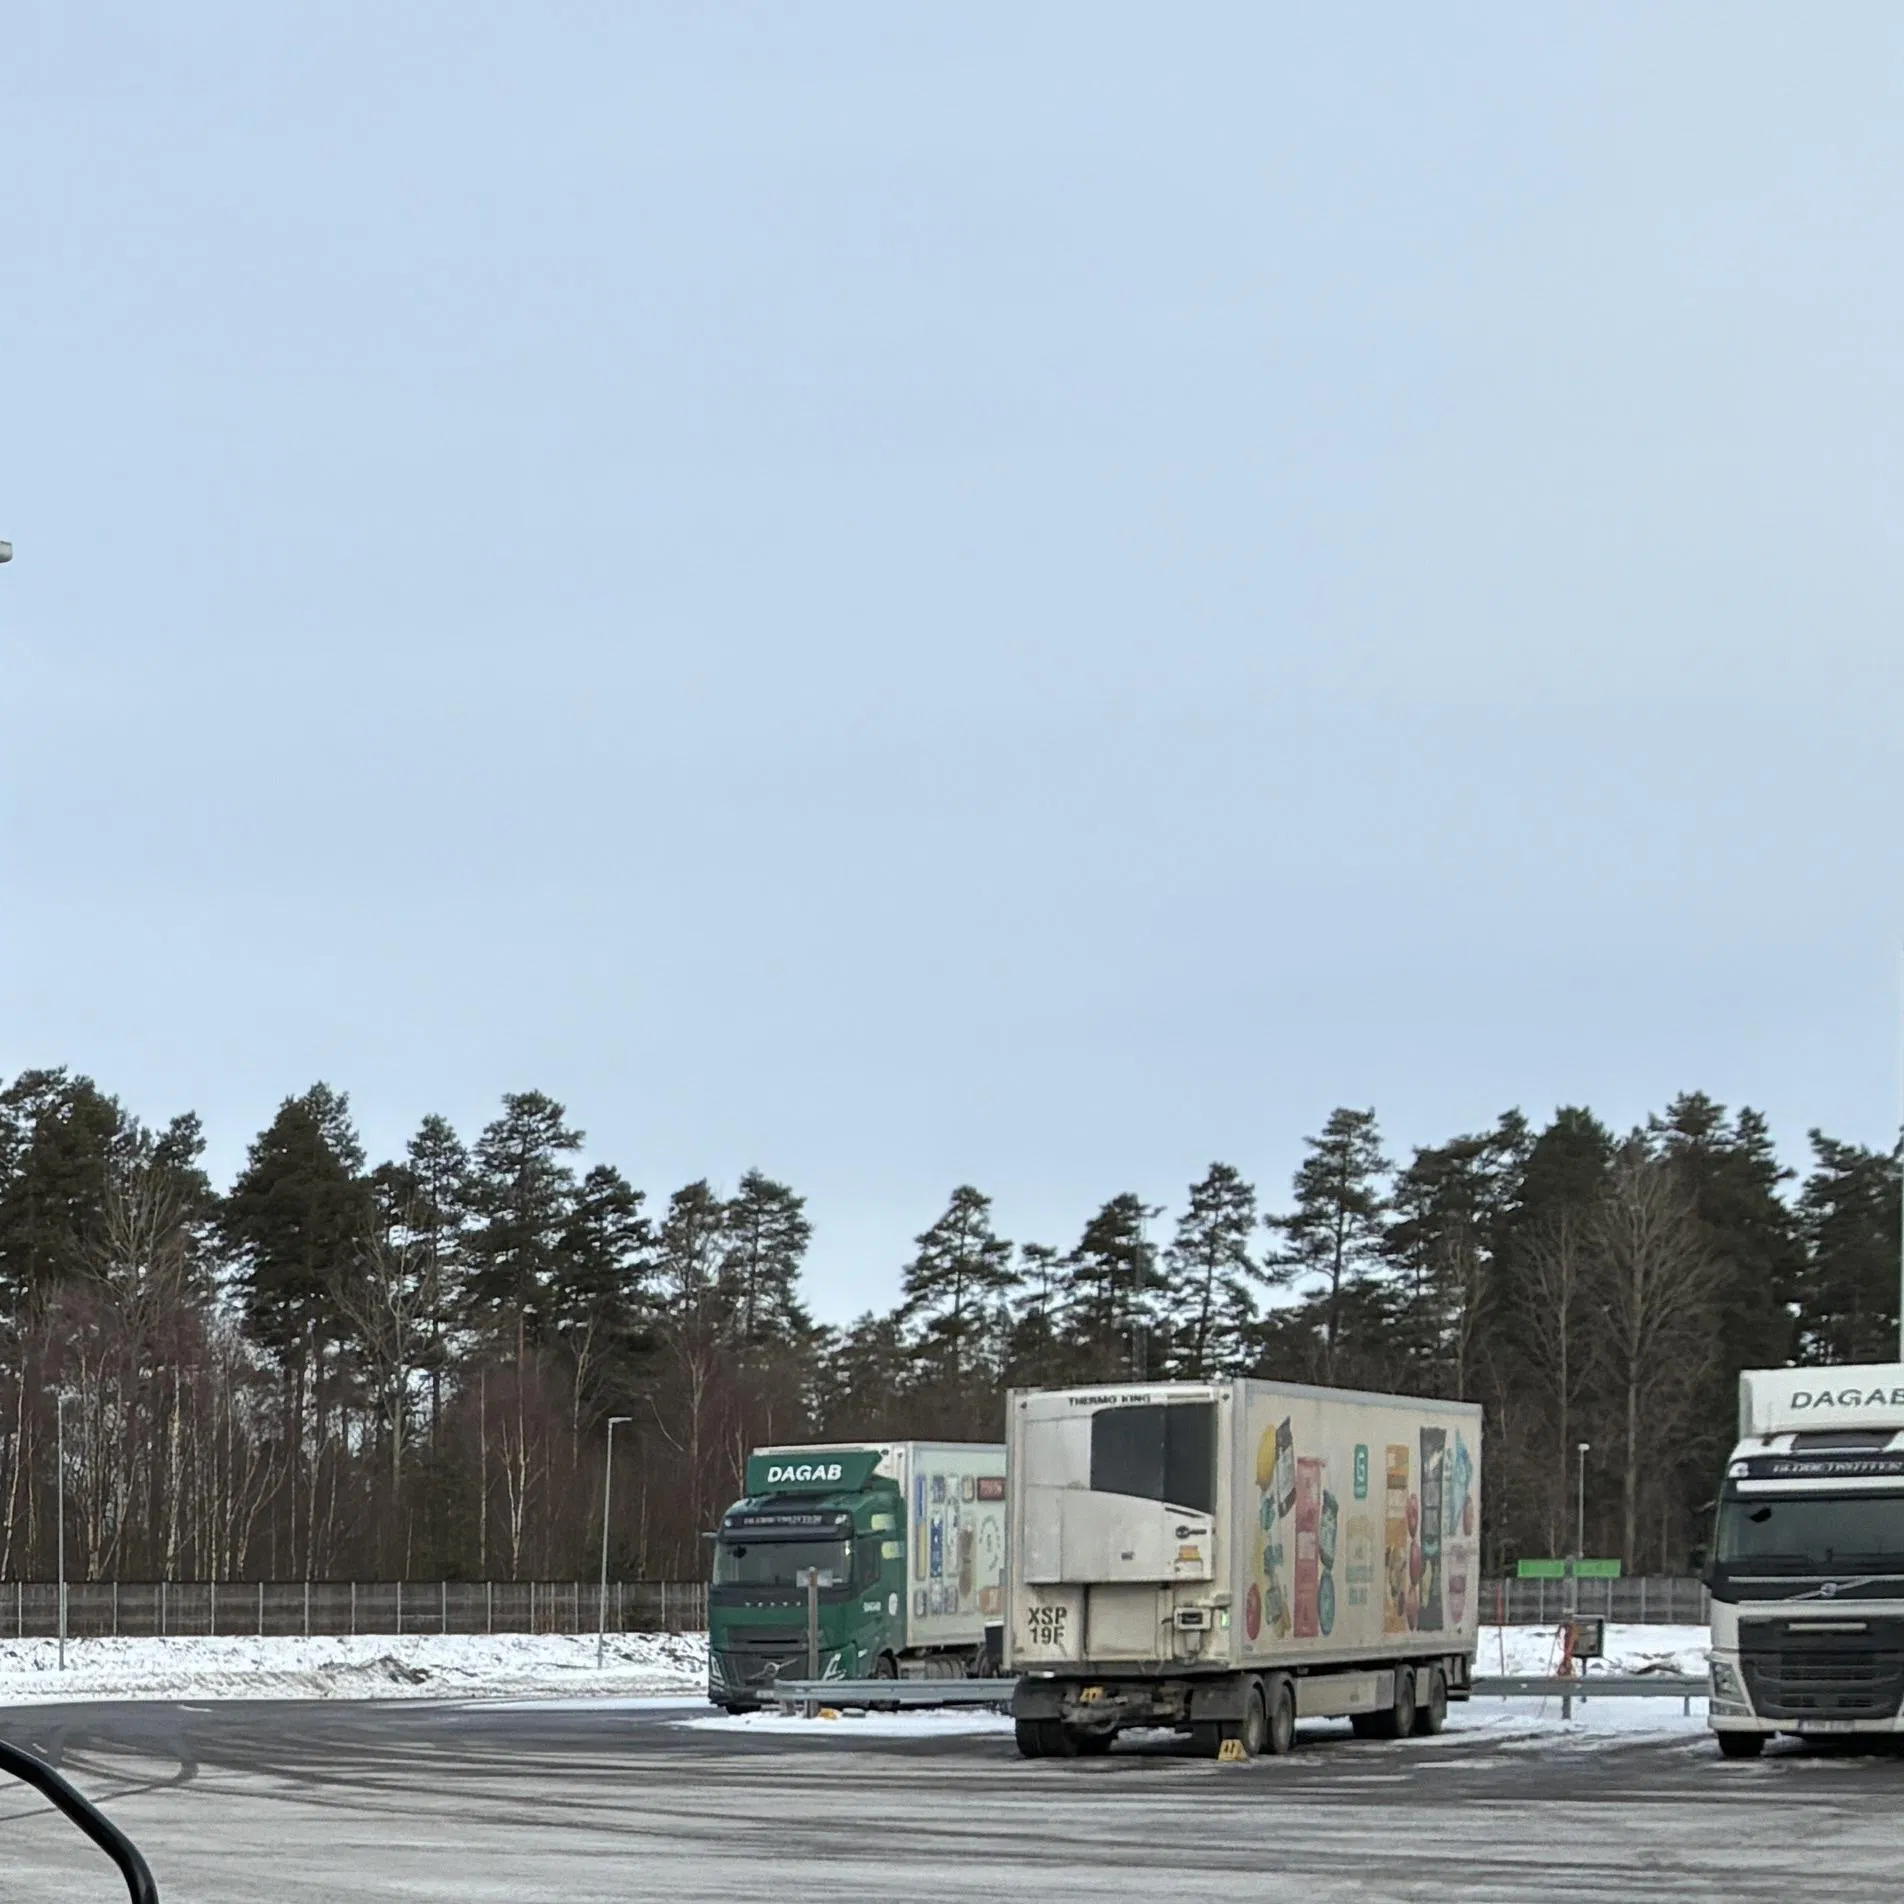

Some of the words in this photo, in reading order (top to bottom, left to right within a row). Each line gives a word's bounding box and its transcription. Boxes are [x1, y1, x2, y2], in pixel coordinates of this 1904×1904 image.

[1790, 1387, 1904, 1410] DAGAB
[767, 1464, 842, 1483] DAGAB
[1028, 1606, 1067, 1625] XSP
